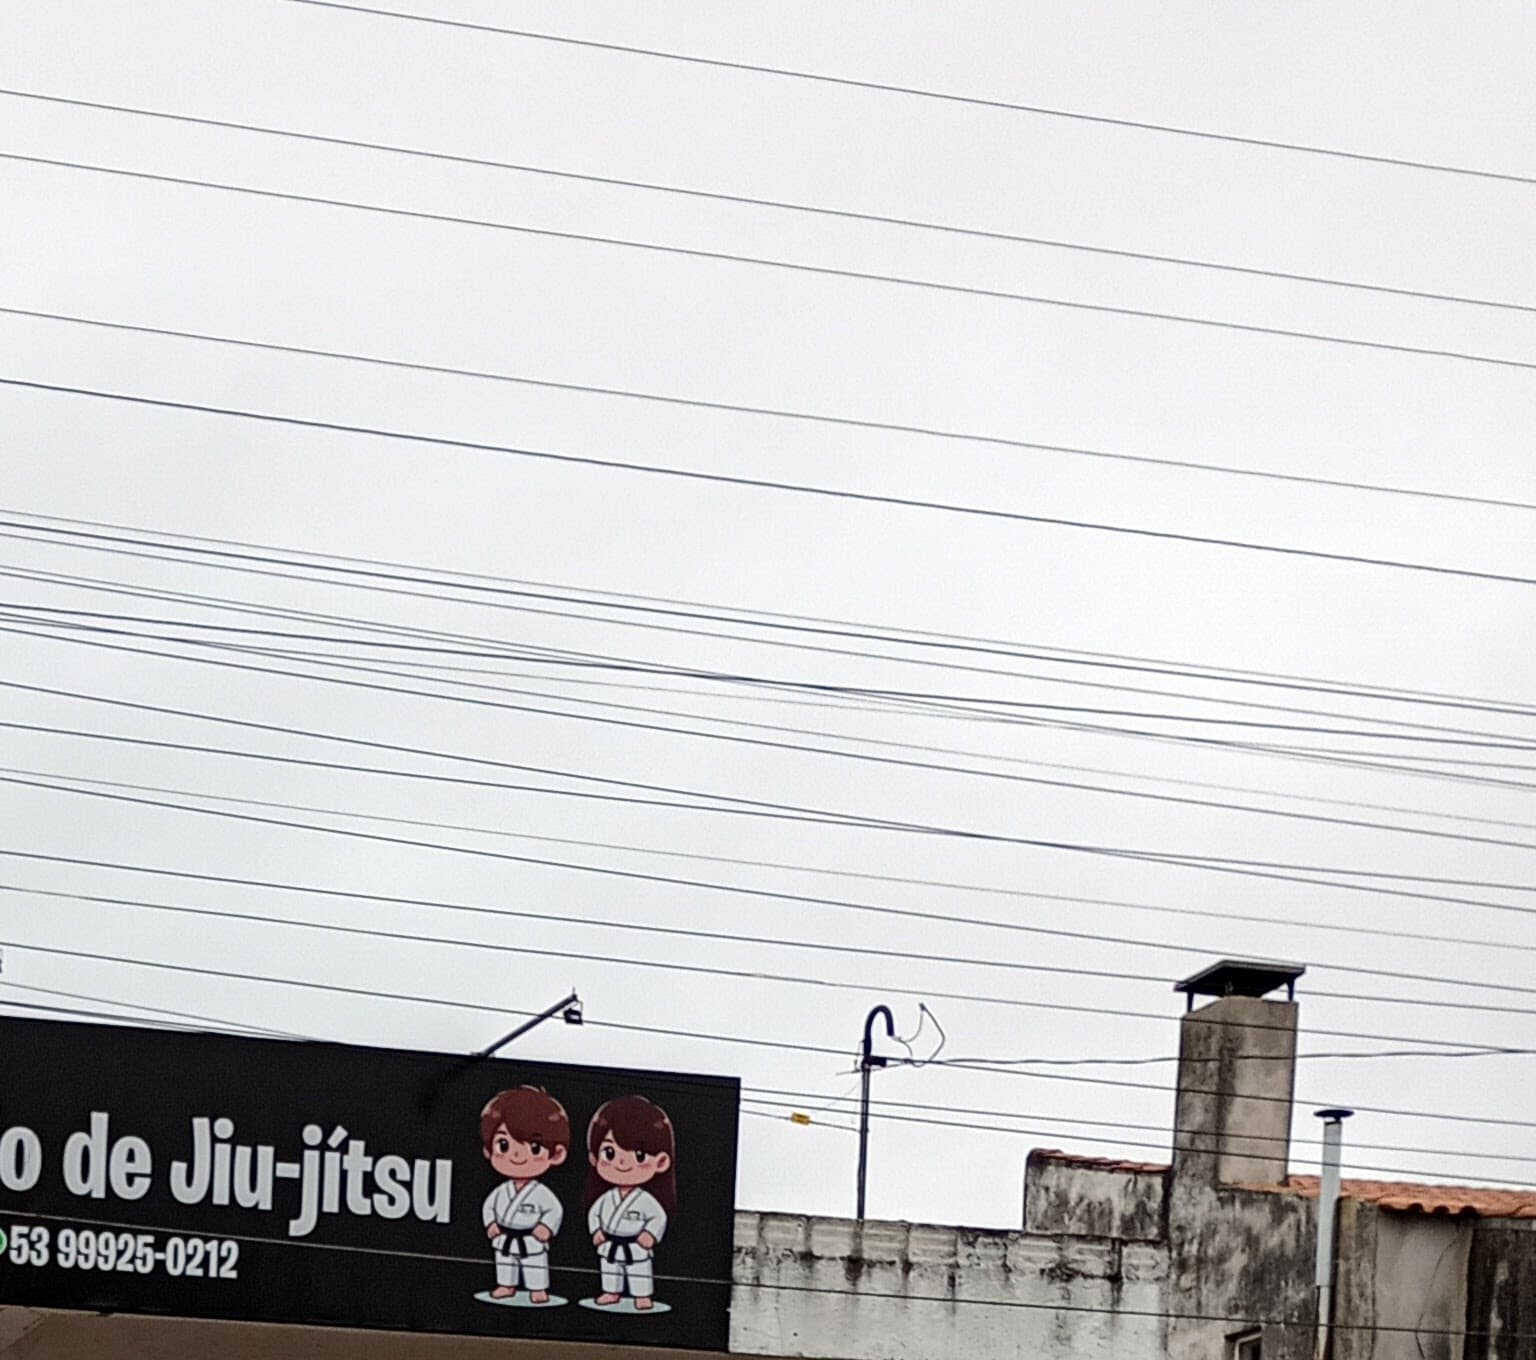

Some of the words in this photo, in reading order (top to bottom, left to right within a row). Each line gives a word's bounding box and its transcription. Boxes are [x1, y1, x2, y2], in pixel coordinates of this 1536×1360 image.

[63, 1111, 153, 1200] de
[170, 1117, 453, 1238] Jiu-jítsu
[9, 1225, 49, 1267] 53
[57, 1229, 240, 1279] 99925-0212
